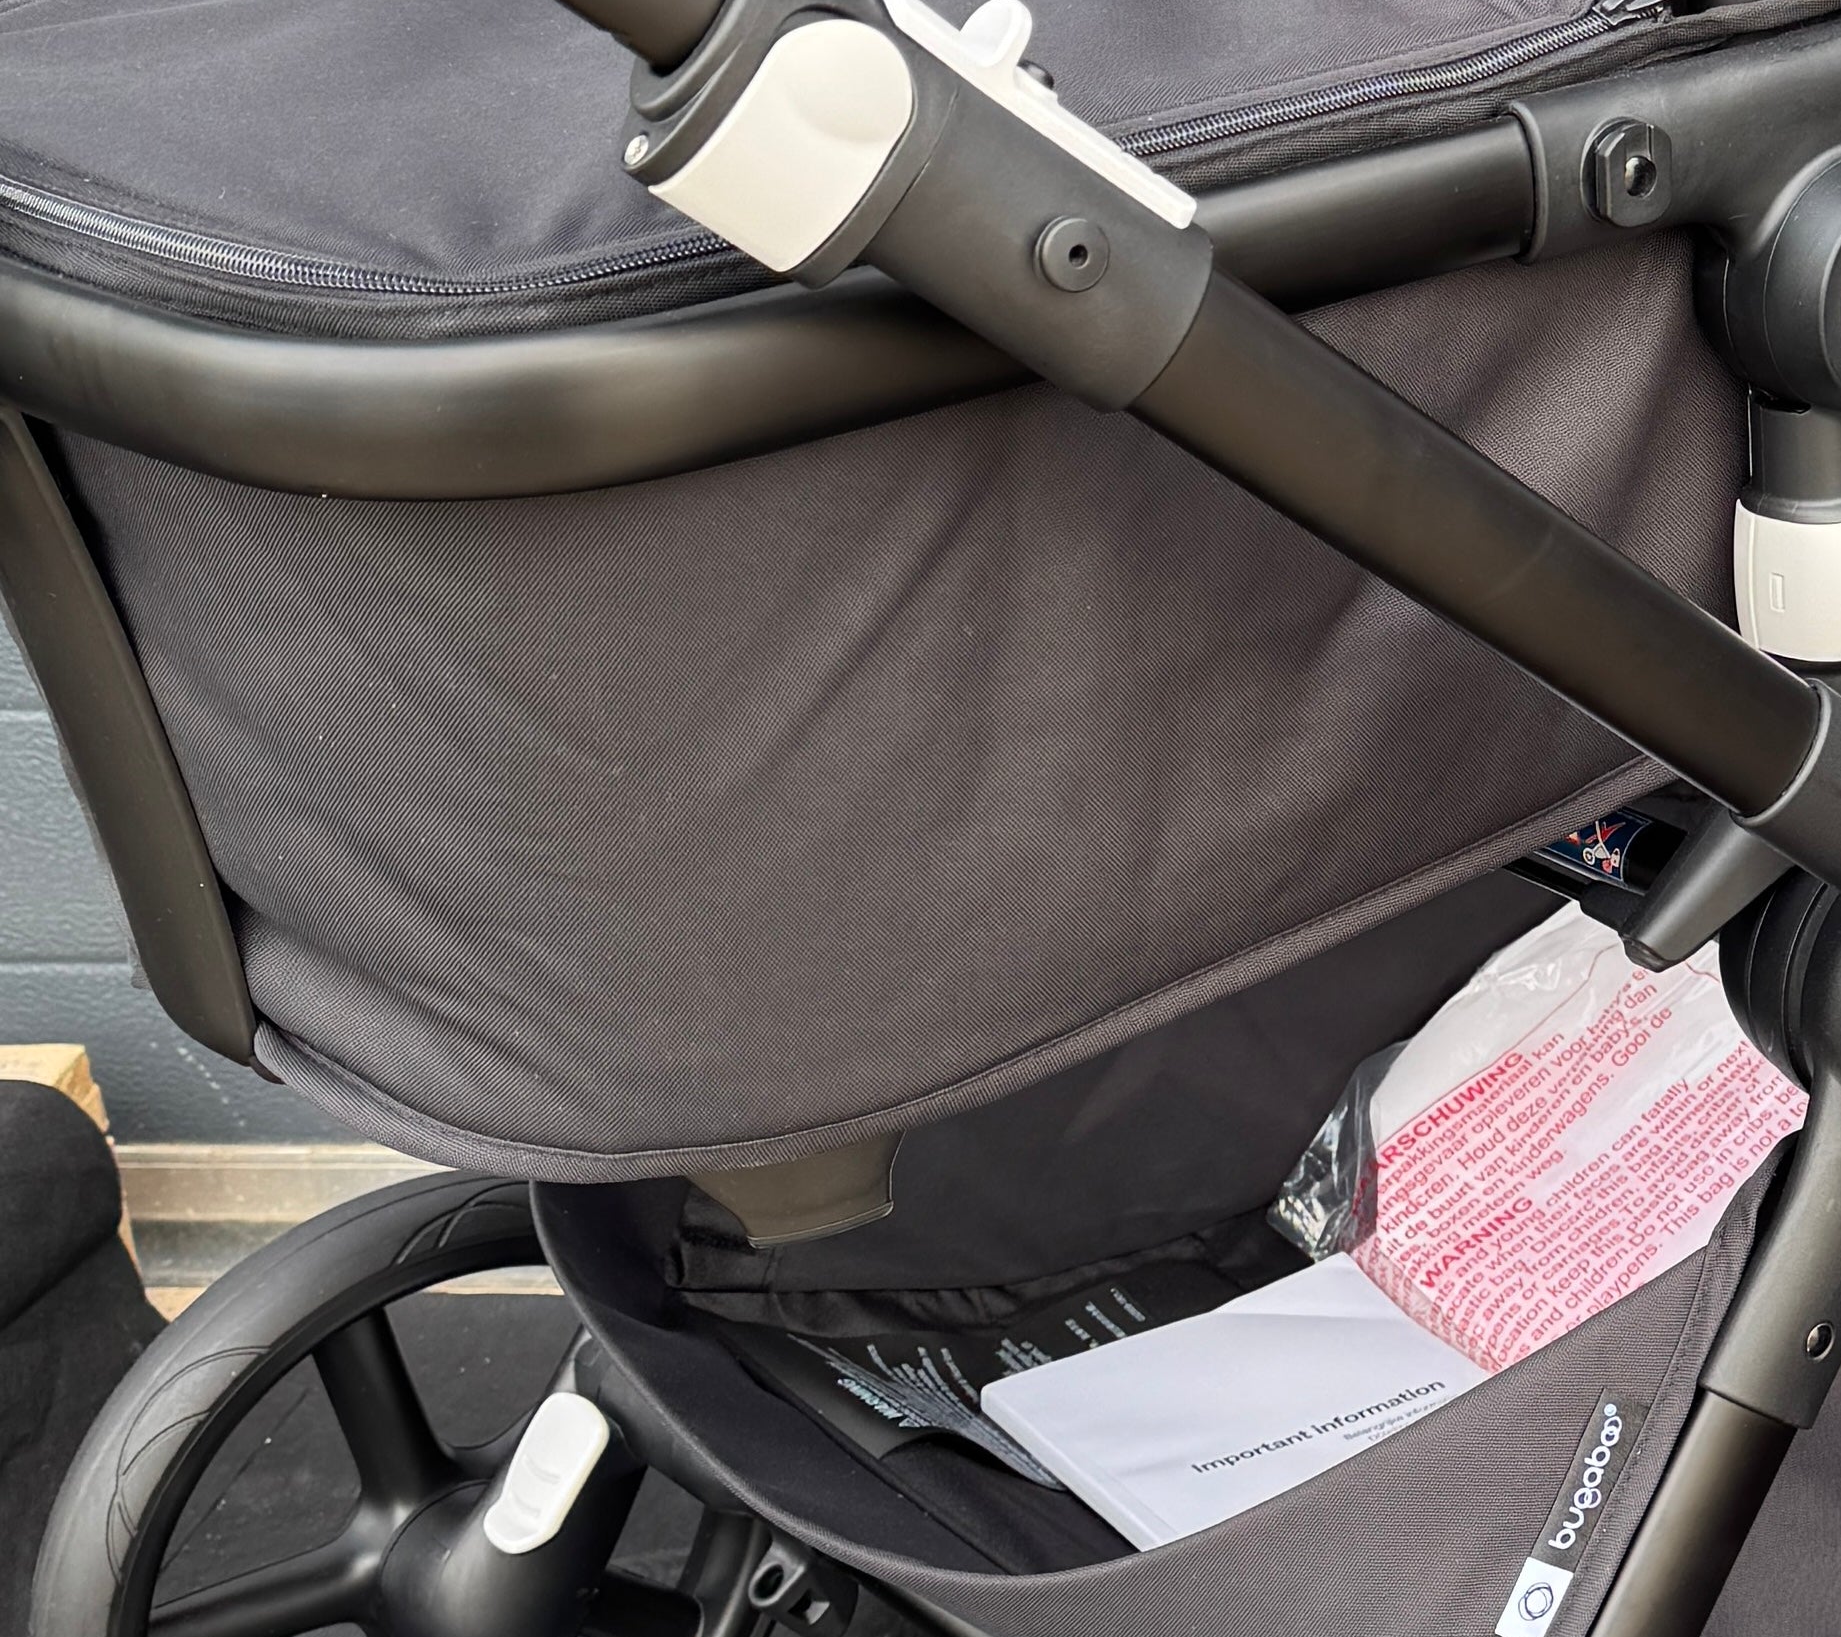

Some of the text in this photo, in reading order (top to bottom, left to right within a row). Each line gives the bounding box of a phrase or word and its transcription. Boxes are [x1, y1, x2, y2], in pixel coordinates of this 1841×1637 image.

[1456, 1127, 1505, 1170] Houd
[1506, 1096, 1547, 1132] deze
[1624, 984, 1657, 1008] dan
[1471, 1067, 1550, 1133] opleveren
[1550, 1035, 1587, 1067] voor
[1531, 1033, 1564, 1060] kan
[1404, 1220, 1428, 1239] de
[1427, 1181, 1474, 1219] buurt
[1474, 1155, 1507, 1181] van
[1504, 1088, 1570, 1156] kinderen
[1569, 1064, 1592, 1085] en
[1425, 1198, 1480, 1238] boxen
[1482, 1177, 1505, 1195] en
[1504, 1073, 1613, 1176] kinderwagens.
[1611, 1029, 1650, 1066] Gooi
[1650, 1007, 1671, 1028] de
[1455, 1246, 1488, 1277] and
[1490, 1208, 1545, 1252] young
[1545, 1153, 1609, 1207] children
[1611, 1124, 1642, 1151] can
[1641, 1079, 1688, 1122] fatally
[1485, 1235, 1533, 1270] when
[1534, 1201, 1571, 1233] their
[1573, 1164, 1620, 1200] faces
[1622, 1136, 1649, 1162] are
[1650, 1093, 1696, 1134] within
[1696, 1074, 1713, 1091] or
[1716, 1040, 1748, 1073] next
[1521, 1281, 1538, 1300] or
[1646, 1151, 1688, 1193] avoid
[1690, 1096, 1741, 1149] danger
[1744, 1077, 1760, 1093] of
[1596, 1175, 1628, 1199] this
[1627, 1144, 1662, 1173] bag
[1659, 1204, 1699, 1234] This
[1696, 1172, 1734, 1203] bag
[1728, 1156, 1749, 1172] is
[1748, 1128, 1778, 1156] not
[1777, 1118, 1791, 1131] a
[1420, 1197, 1532, 1287] WARNING
[1462, 1181, 1525, 1230] meteen
[1531, 1306, 1563, 1341] and
[1656, 1194, 1683, 1222] not
[1683, 1165, 1714, 1193] use
[1712, 1147, 1733, 1164] in
[1545, 1258, 1589, 1297] keep
[1590, 1234, 1624, 1257] this
[1626, 1182, 1675, 1234] plastic
[1675, 1150, 1709, 1179] bag
[1709, 1107, 1750, 1148] away
[1482, 1277, 1523, 1321] away
[1524, 1244, 1566, 1275] from
[1191, 1430, 1313, 1473] Important
[1310, 1381, 1446, 1435] information
[1547, 1415, 1623, 1551] bugaboo
